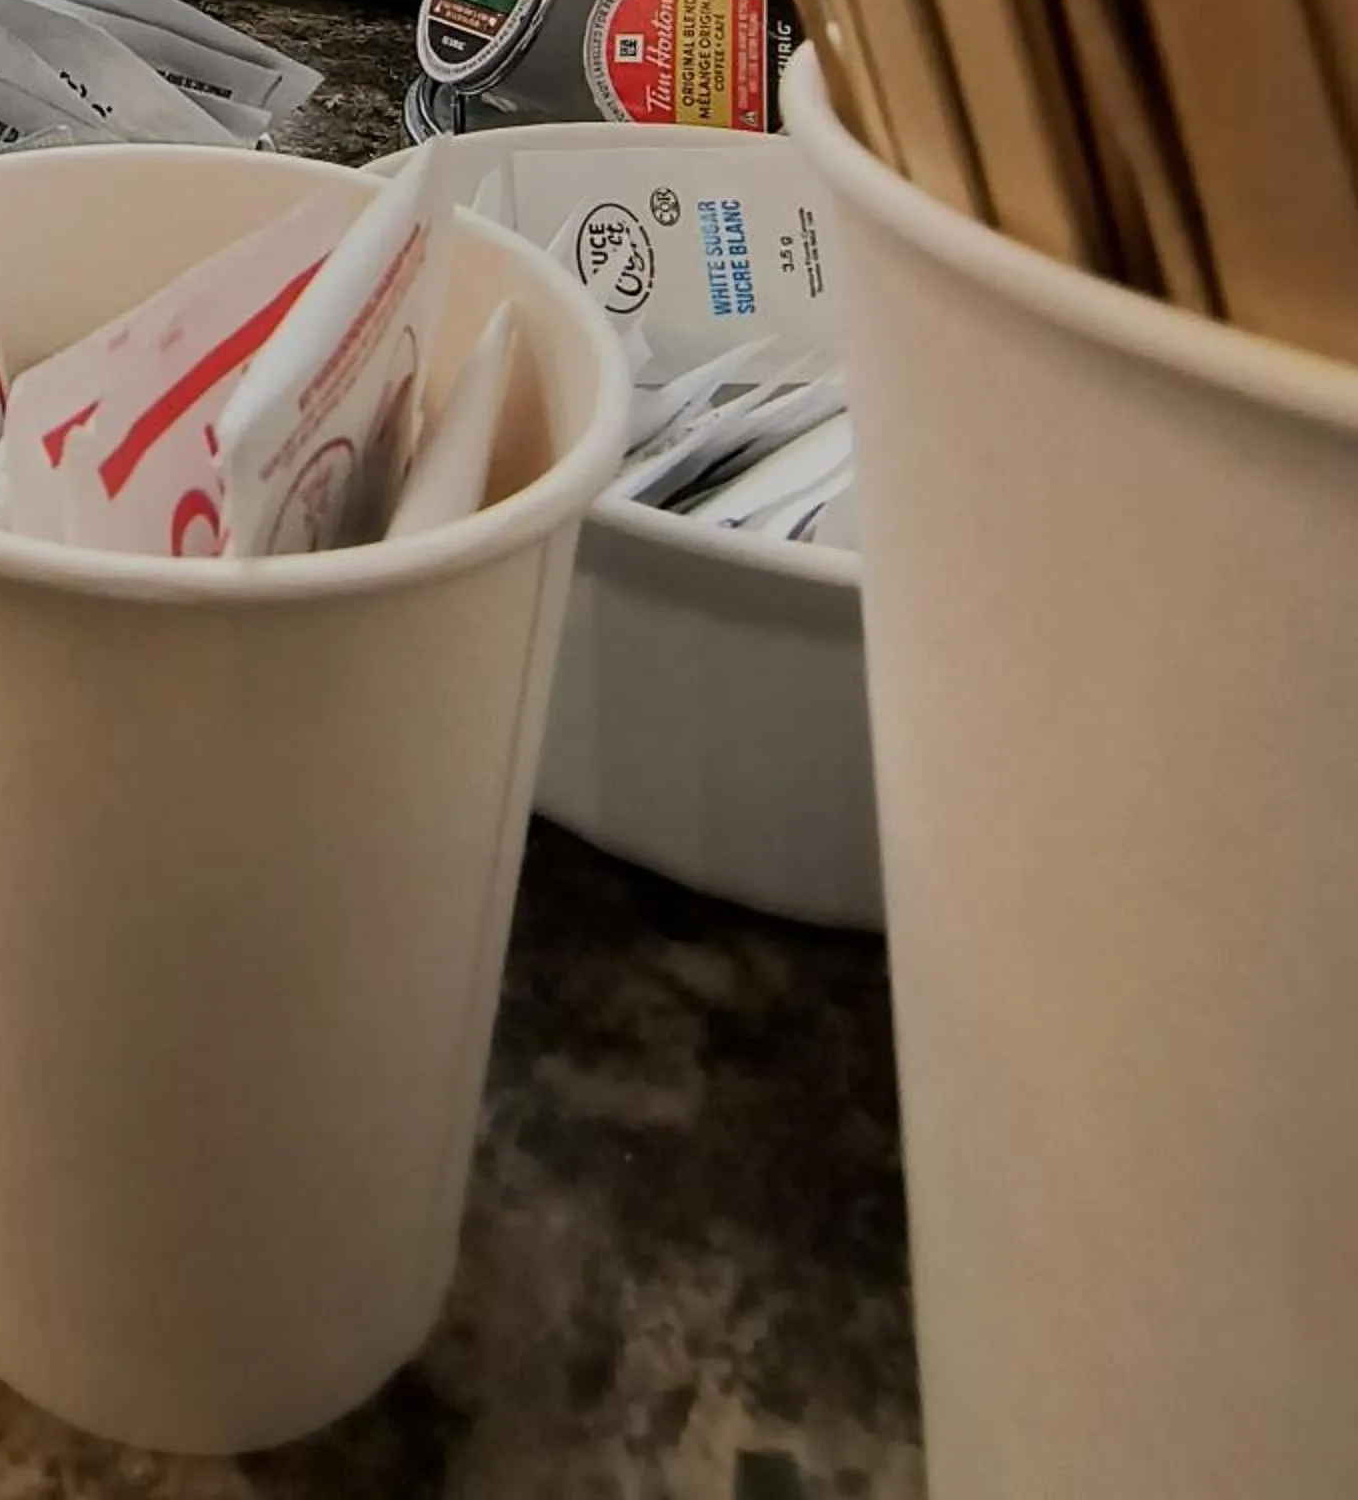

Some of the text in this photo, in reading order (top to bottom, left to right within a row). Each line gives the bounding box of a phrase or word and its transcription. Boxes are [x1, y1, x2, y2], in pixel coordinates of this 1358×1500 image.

[681, 42, 696, 107] ORIGINAL
[714, 49, 726, 93] COFFEE
[777, 20, 792, 71] URIG
[645, 70, 672, 113] Tim
[697, 52, 712, 119] MÉLANGE
[698, 201, 733, 315] WHITE SUGAR
[721, 200, 756, 314] SUCRE BLANC
